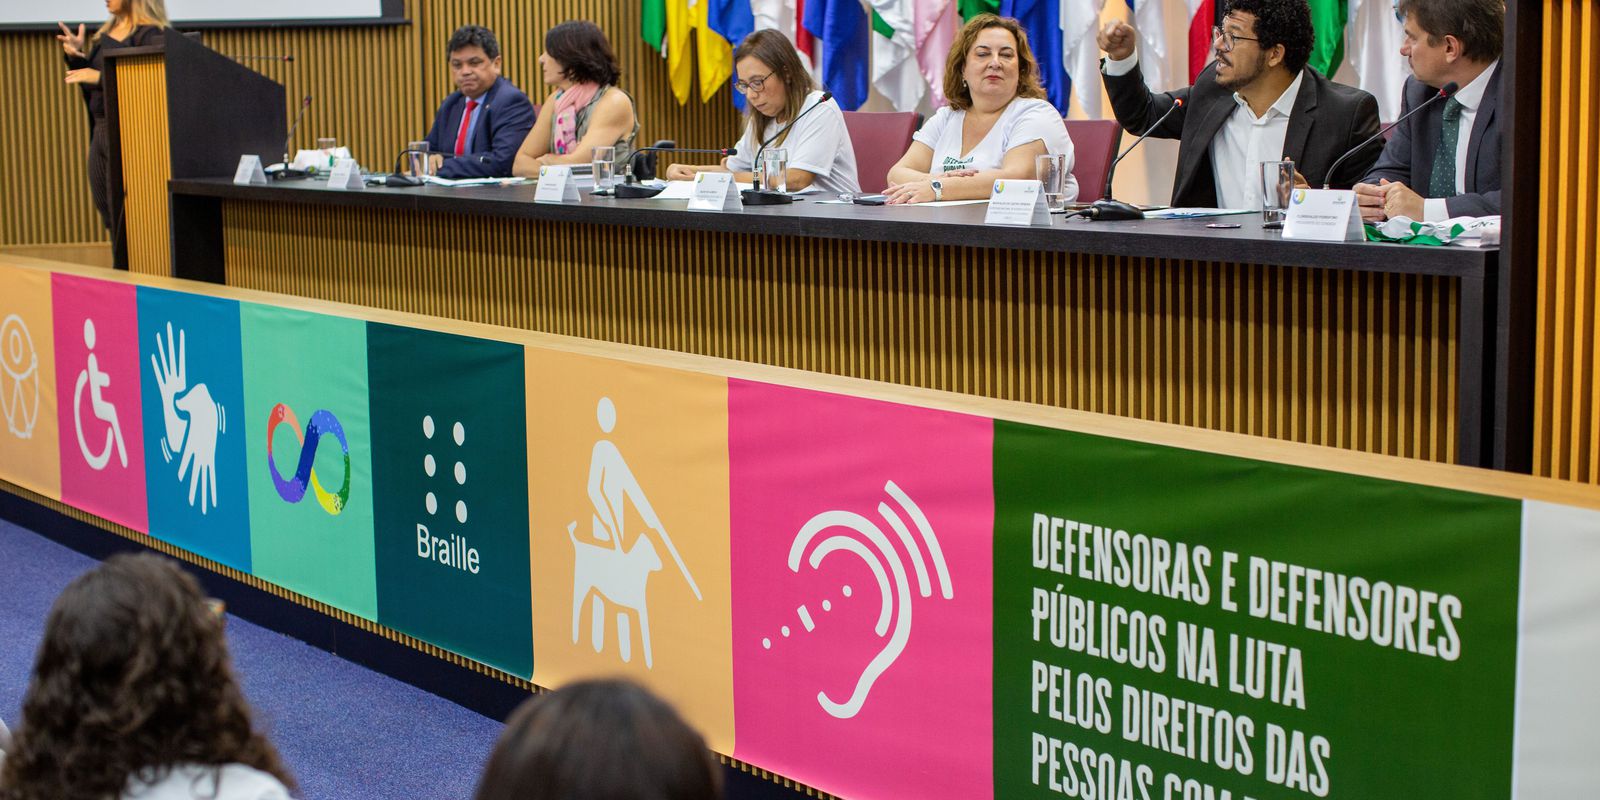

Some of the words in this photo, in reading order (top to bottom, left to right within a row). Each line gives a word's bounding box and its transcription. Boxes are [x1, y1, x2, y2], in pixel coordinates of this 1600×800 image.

[417, 523, 480, 574] Braille
[1033, 513, 1211, 605] DEFENSORAS
[1222, 552, 1238, 612] E
[1250, 556, 1462, 661] DEFENSORES
[1031, 584, 1167, 673] PÚBLICOS
[1178, 622, 1219, 688] NA
[1230, 634, 1306, 710] LUTA
[1032, 660, 1113, 734] PELOS
[1123, 685, 1254, 776] DIREITOS
[1266, 723, 1331, 798] DAS
[1032, 732, 1153, 800] PESSOAS
